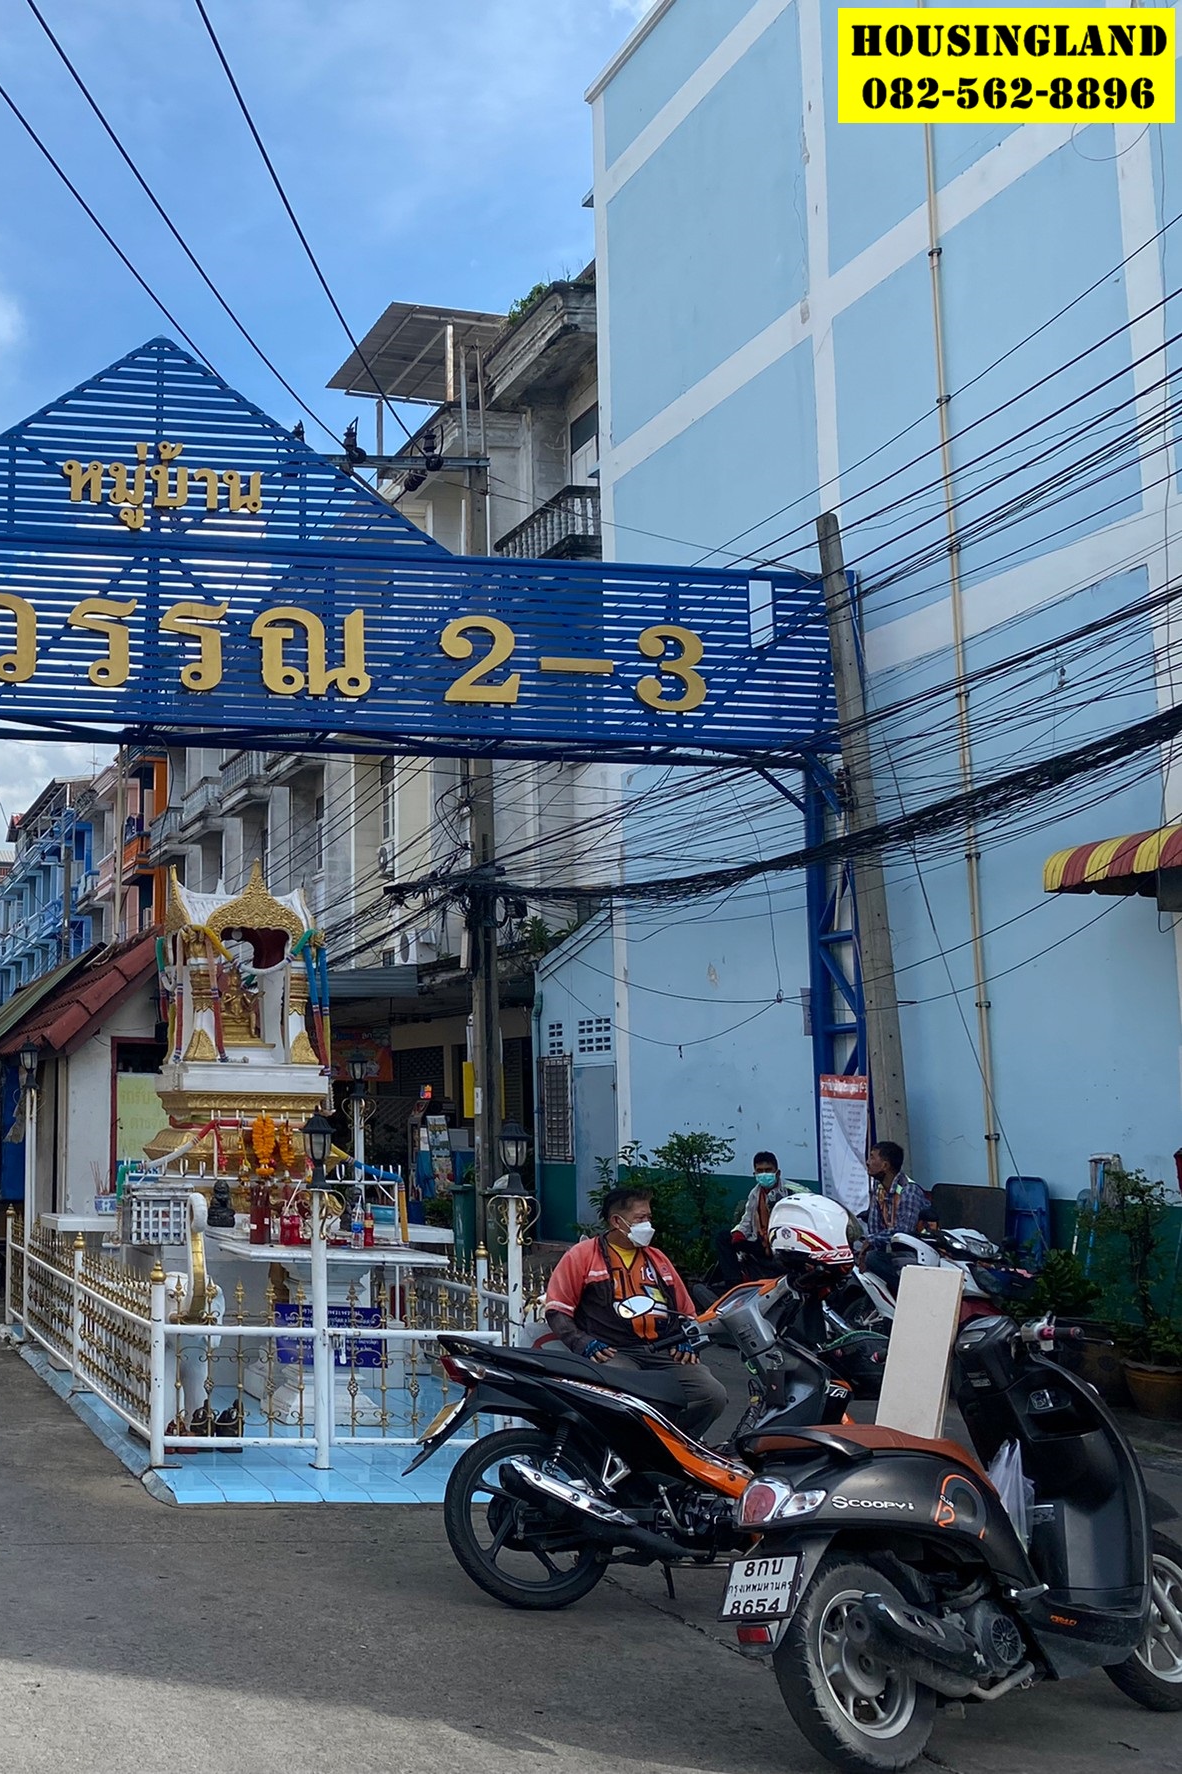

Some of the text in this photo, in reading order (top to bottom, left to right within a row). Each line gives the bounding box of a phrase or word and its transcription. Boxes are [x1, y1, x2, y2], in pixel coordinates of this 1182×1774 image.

[63, 441, 263, 529] หมู่บ้าน
[744, 1559, 784, 1577] 8กบ
[728, 1581, 793, 1597] กรุงเทพมหานคร
[730, 1597, 780, 1614] 8654
